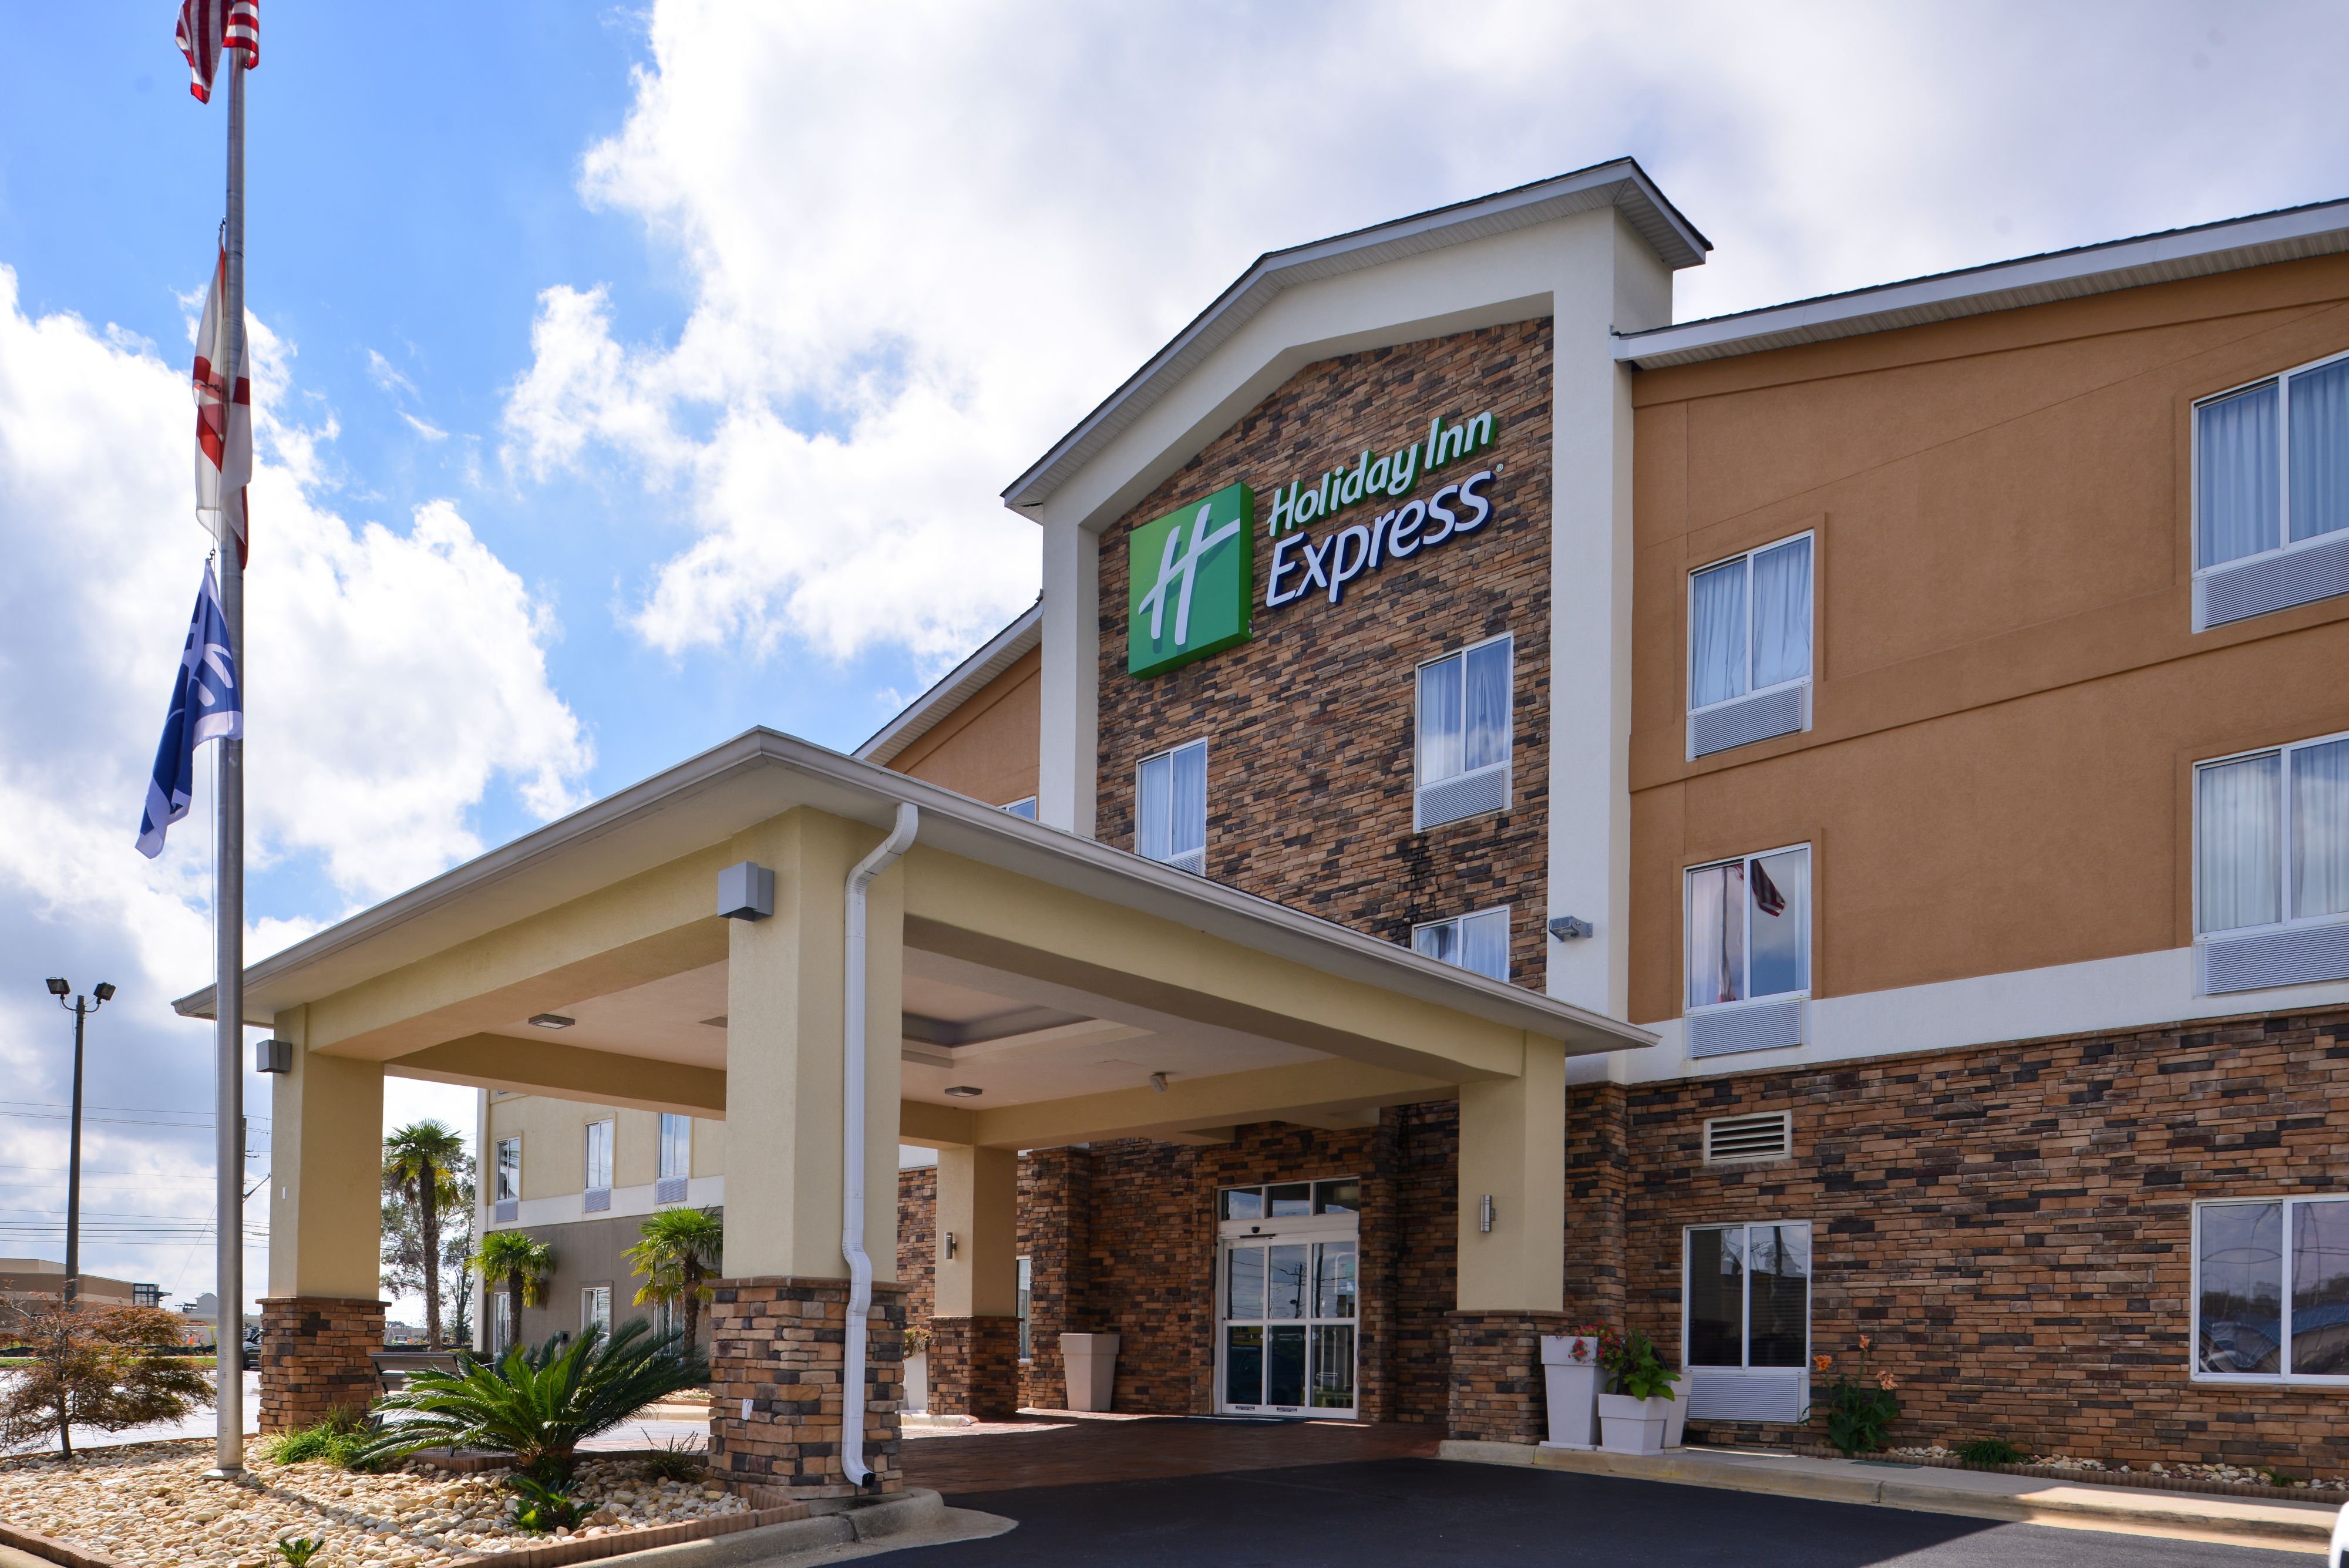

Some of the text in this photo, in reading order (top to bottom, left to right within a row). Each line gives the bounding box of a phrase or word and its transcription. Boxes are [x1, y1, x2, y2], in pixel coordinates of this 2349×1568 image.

[1266, 470, 1494, 608] Express
[1267, 411, 1496, 538] Holiday Inn
